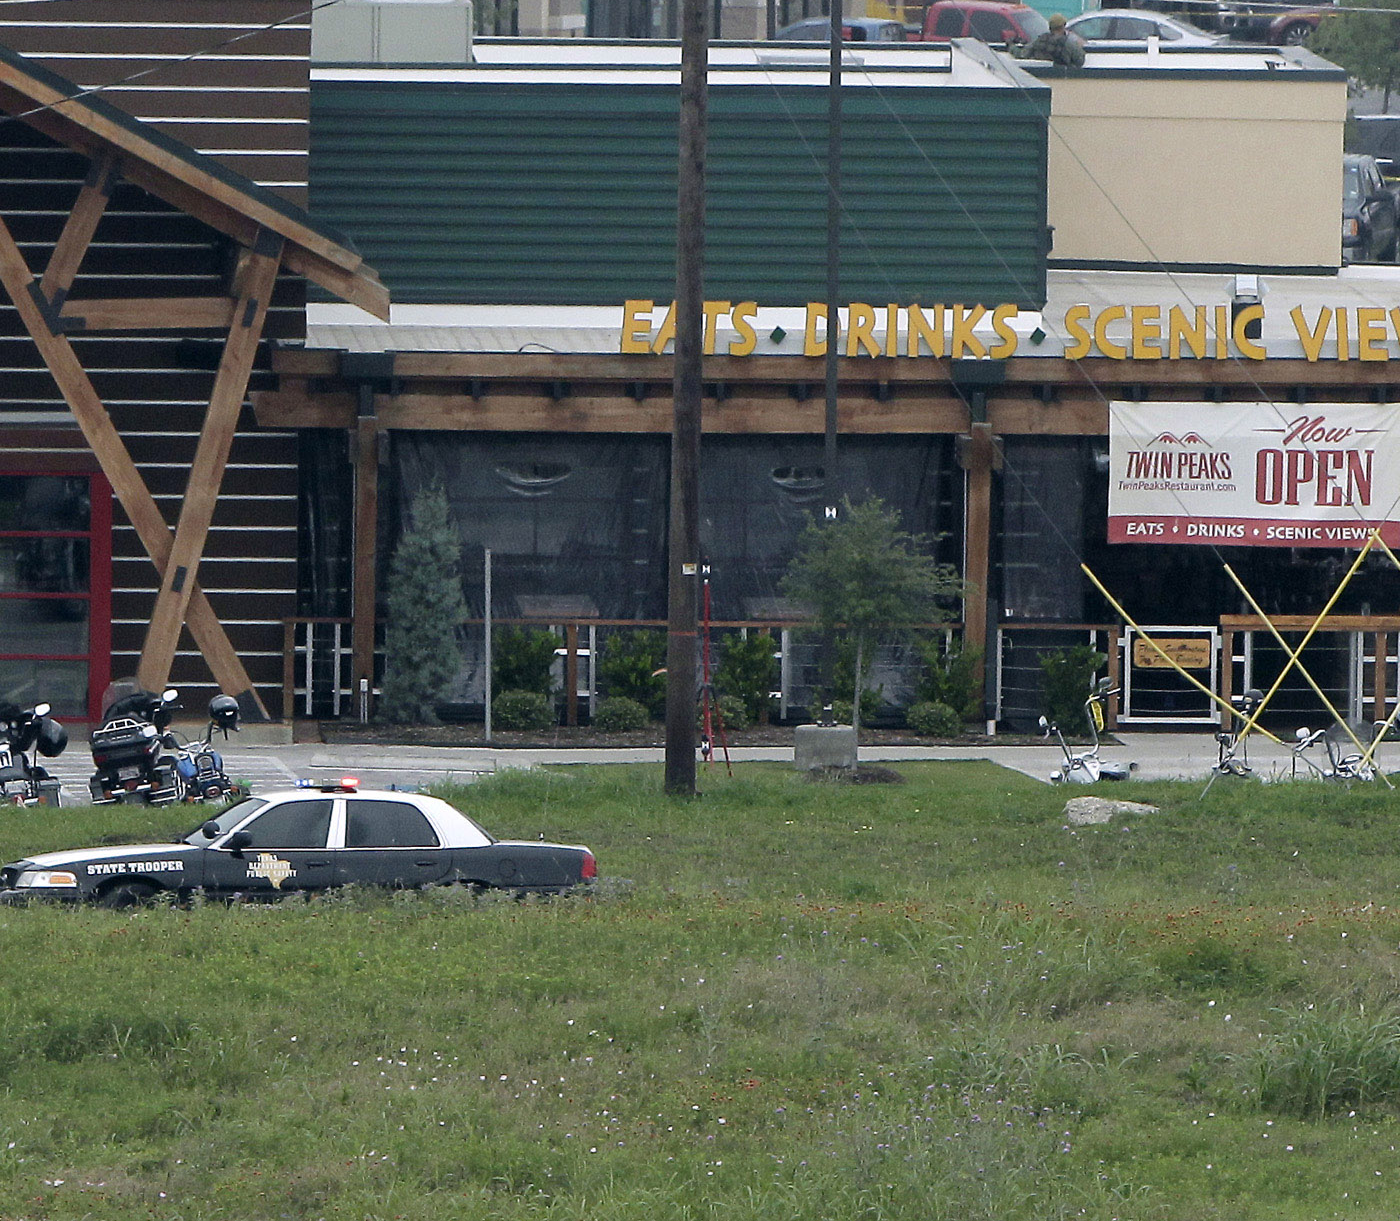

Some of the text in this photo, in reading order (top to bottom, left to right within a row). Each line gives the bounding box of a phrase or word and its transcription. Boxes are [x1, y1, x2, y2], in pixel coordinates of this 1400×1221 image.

[803, 302, 1019, 358] DRINKS
[1064, 304, 1267, 360] SCENIC
[1282, 416, 1354, 446] Now
[1126, 451, 1233, 480] TWIN PEAKS
[1255, 449, 1374, 507] OPEN
[1118, 480, 1236, 492] TwinPeaksRestaurant.com
[1126, 522, 1376, 541] EATS DRINKS SCENIC VIEWS
[87, 861, 184, 875] STATE TROOPER
